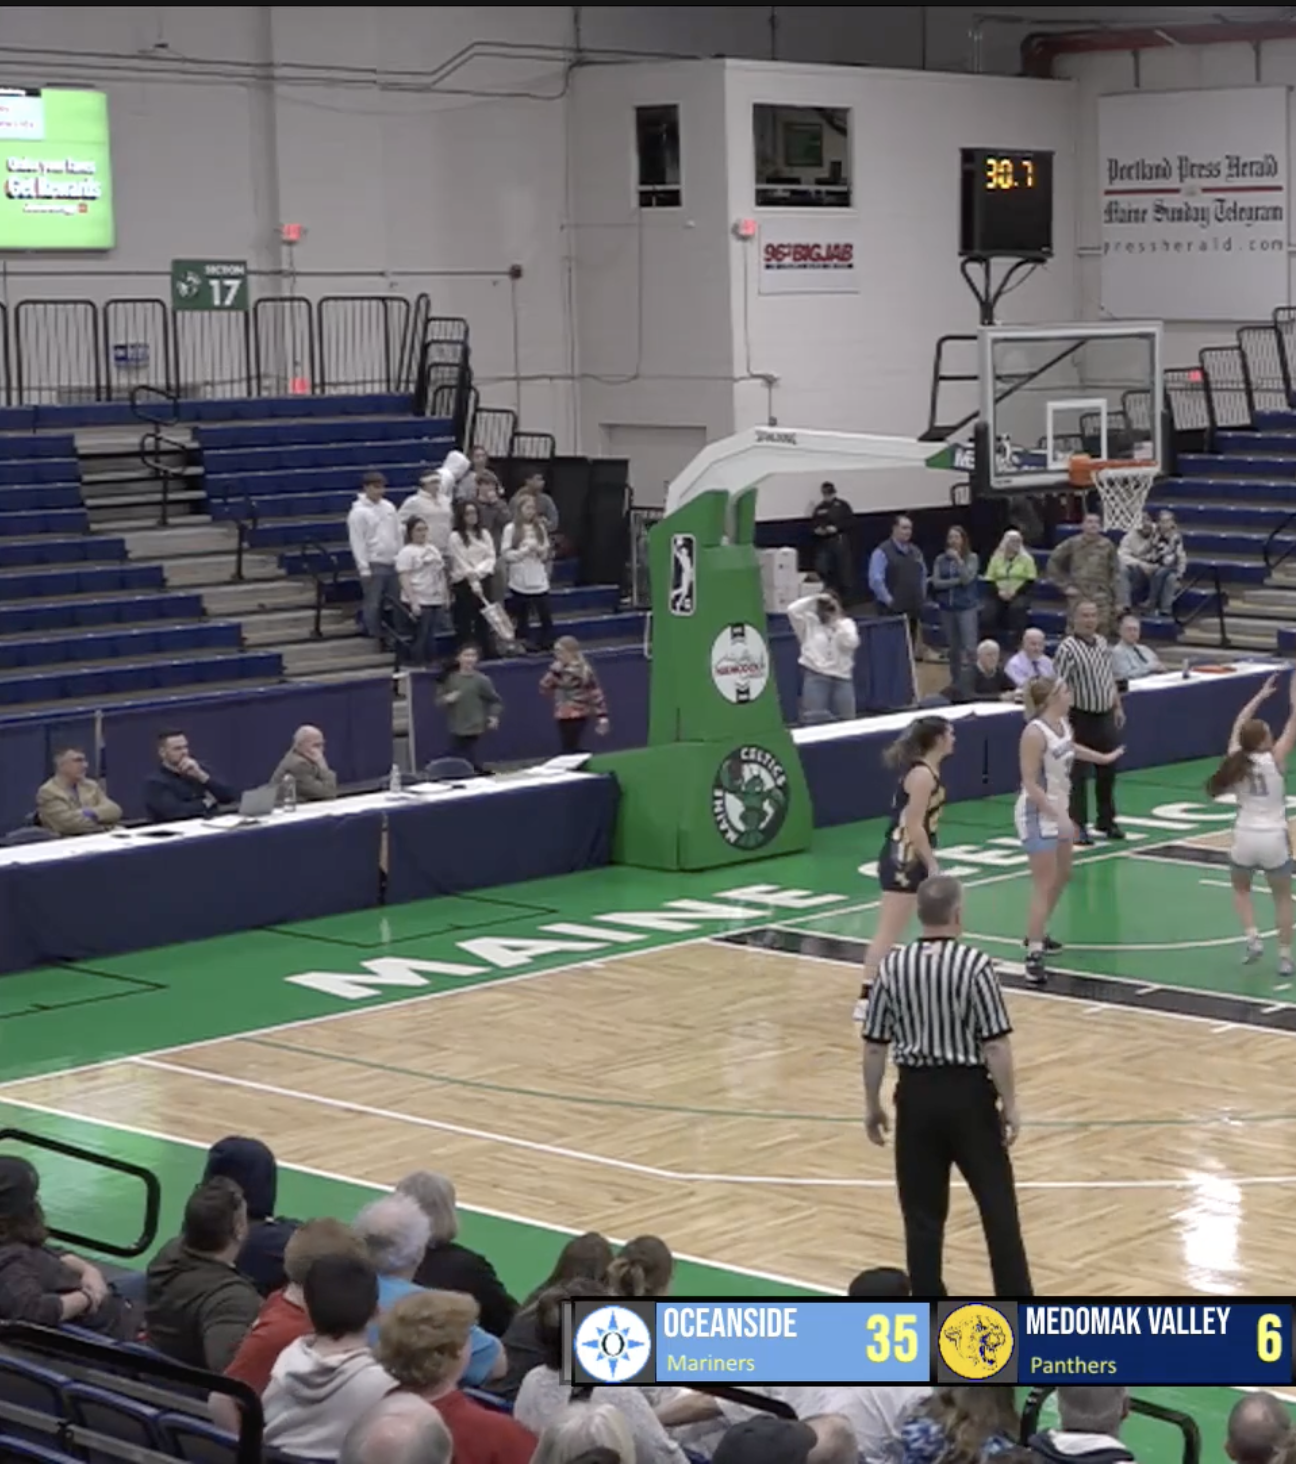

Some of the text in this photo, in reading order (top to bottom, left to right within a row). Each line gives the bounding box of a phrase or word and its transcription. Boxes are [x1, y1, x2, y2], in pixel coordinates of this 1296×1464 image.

[1107, 154, 1278, 185] Portland Press Herald
[1152, 200, 1210, 228] Sunday
[1213, 198, 1284, 227] Telegram
[208, 279, 242, 306] 17
[713, 746, 787, 844] MAINE CELTICS
[284, 884, 849, 1000] MAINE
